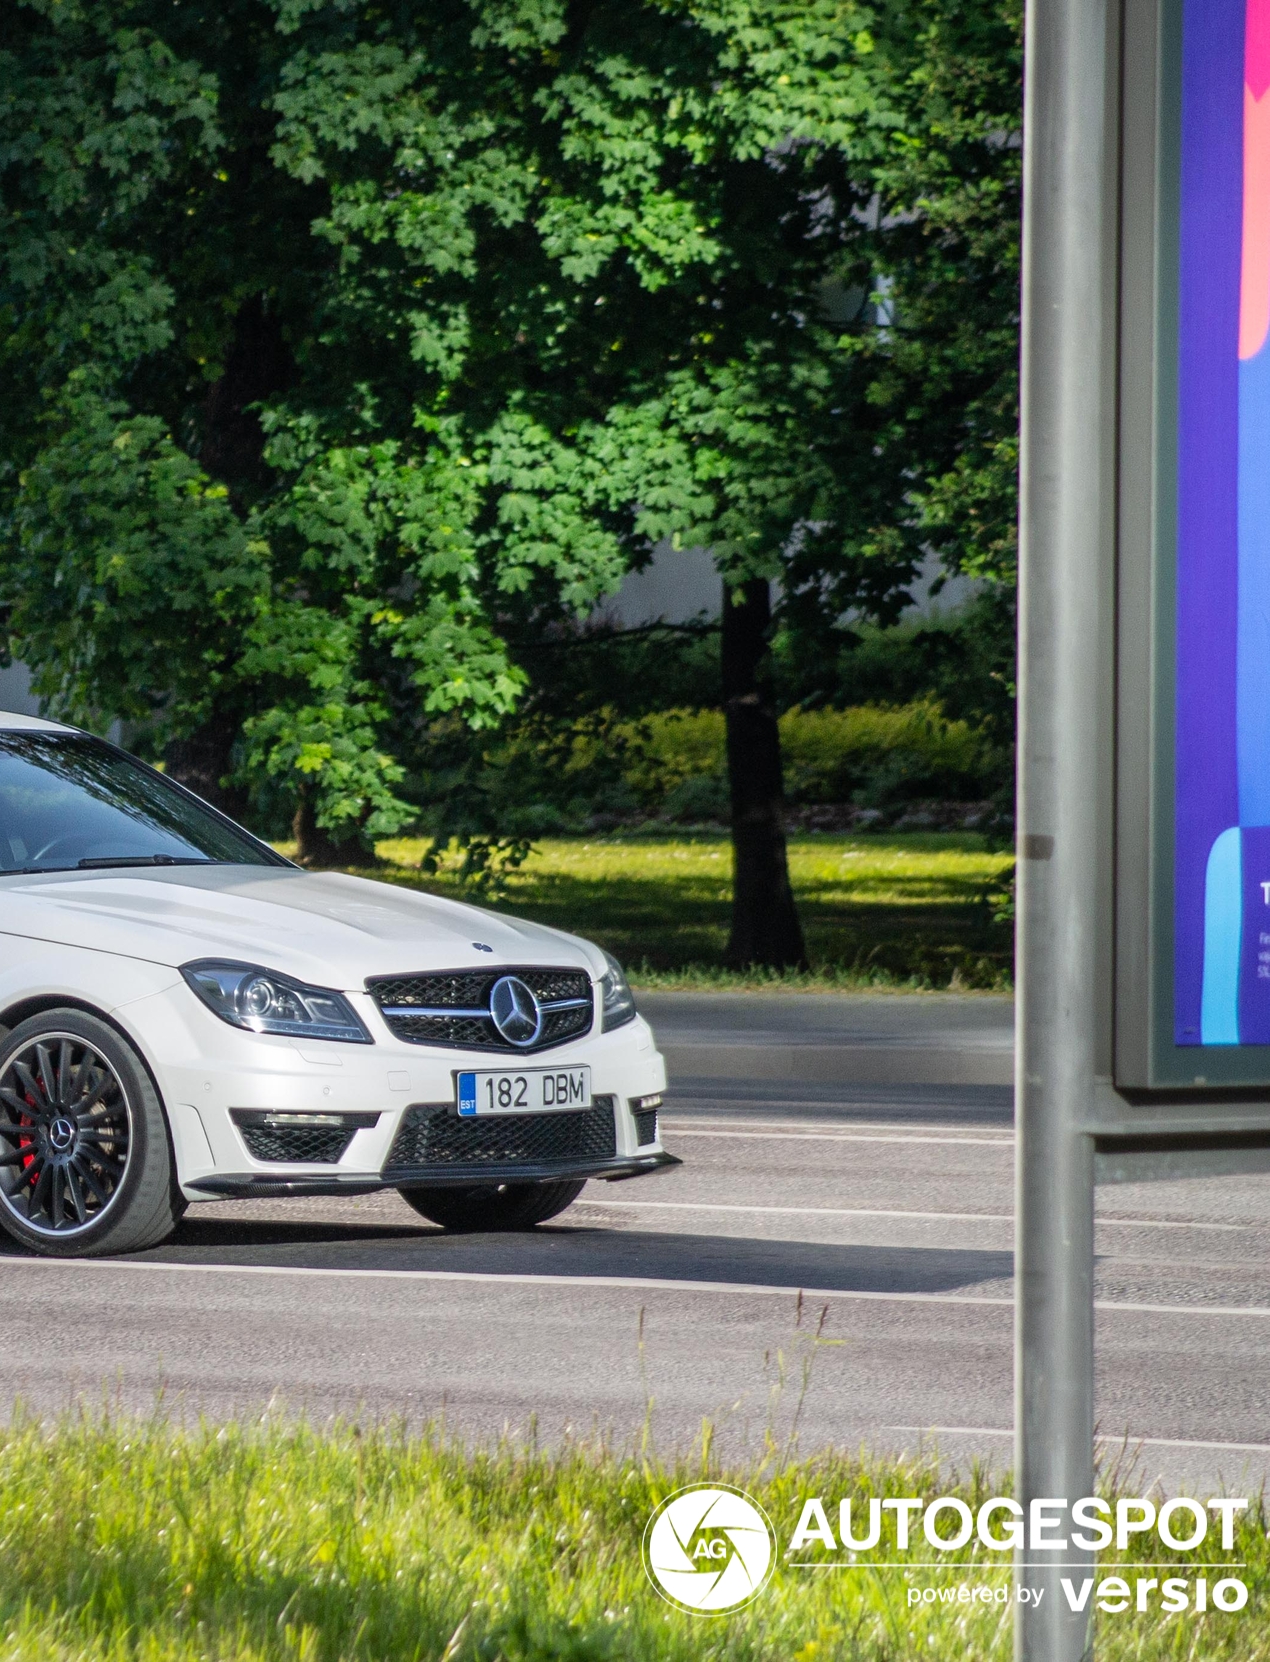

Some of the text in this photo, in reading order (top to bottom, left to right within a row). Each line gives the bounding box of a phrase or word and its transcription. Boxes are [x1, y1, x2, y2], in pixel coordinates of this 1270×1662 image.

[485, 1072, 584, 1109] 182 DBM
[460, 1099, 475, 1110] EST
